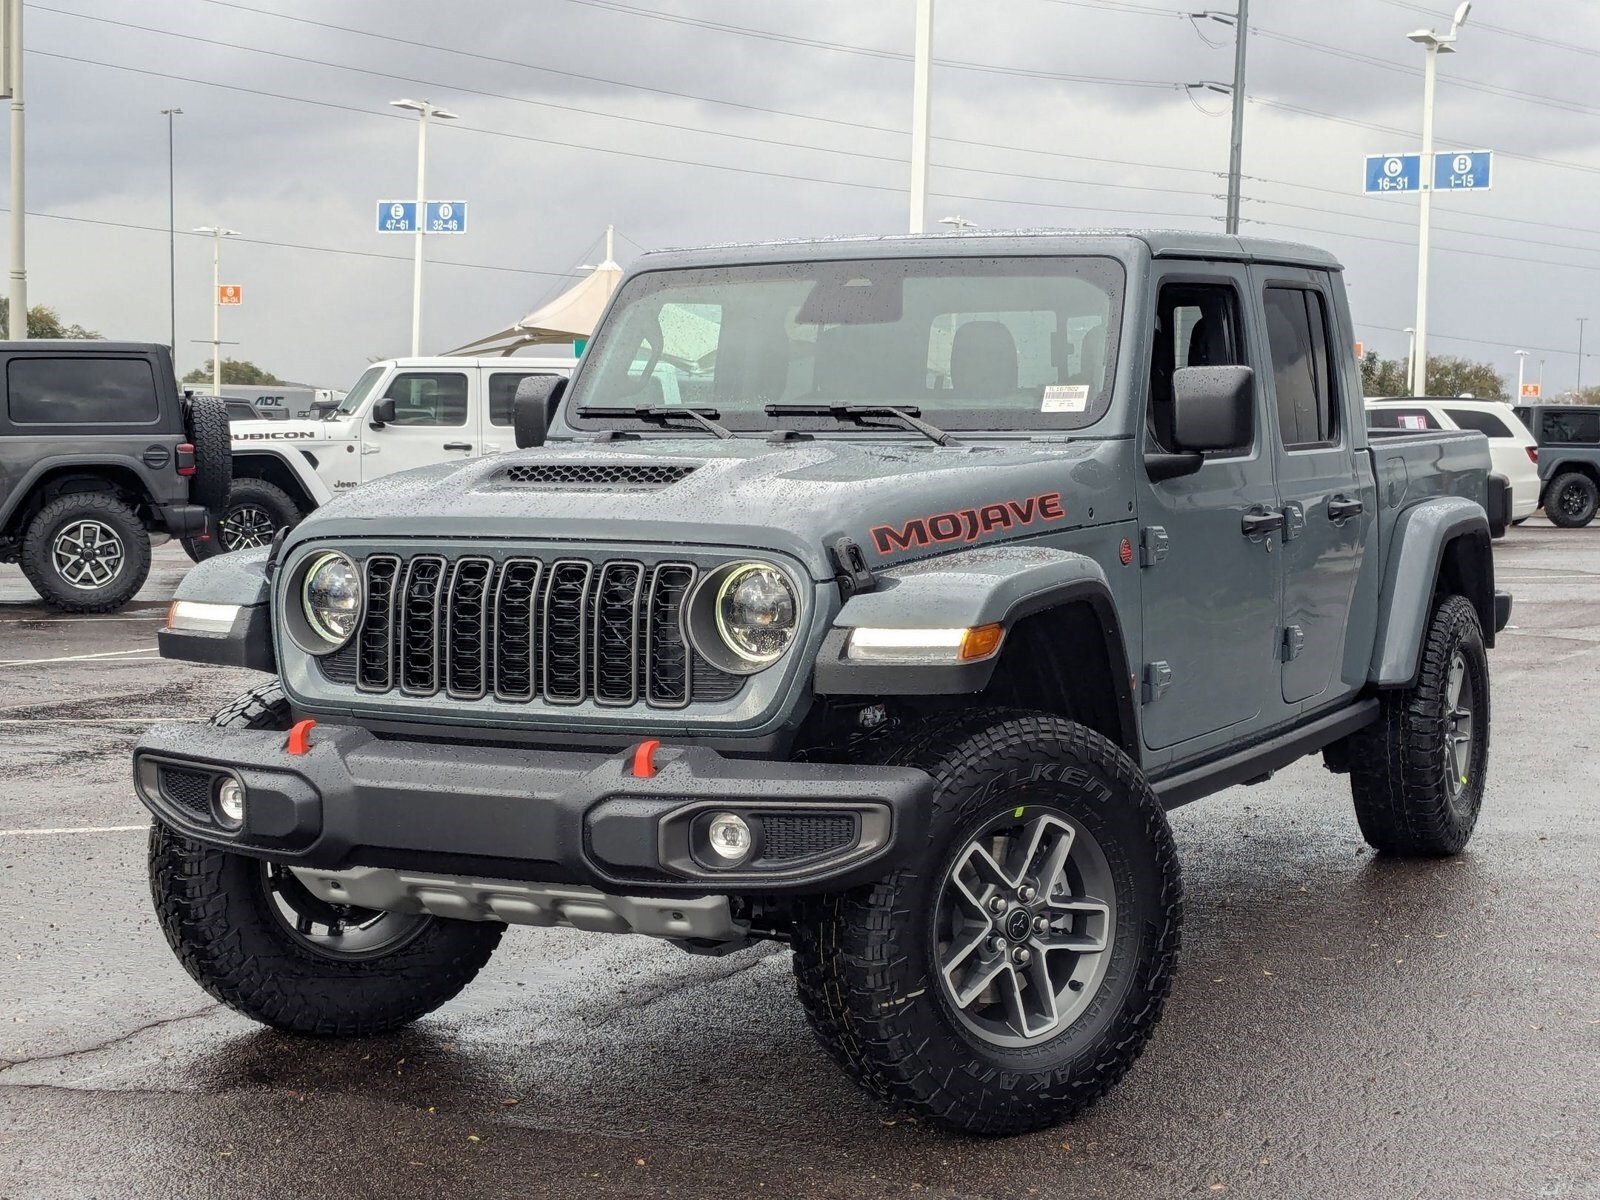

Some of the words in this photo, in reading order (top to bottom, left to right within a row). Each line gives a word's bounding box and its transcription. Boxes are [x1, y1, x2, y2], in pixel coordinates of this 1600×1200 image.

[1388, 160, 1398, 174] C
[1458, 157, 1468, 171] B
[1377, 177, 1408, 190] 16-31
[1449, 175, 1474, 187] 1-15
[394, 205, 401, 217] E
[443, 205, 450, 217] D
[385, 220, 409, 230] 47-61
[433, 220, 458, 230] 32-46
[870, 492, 1066, 556] MOJAVE
